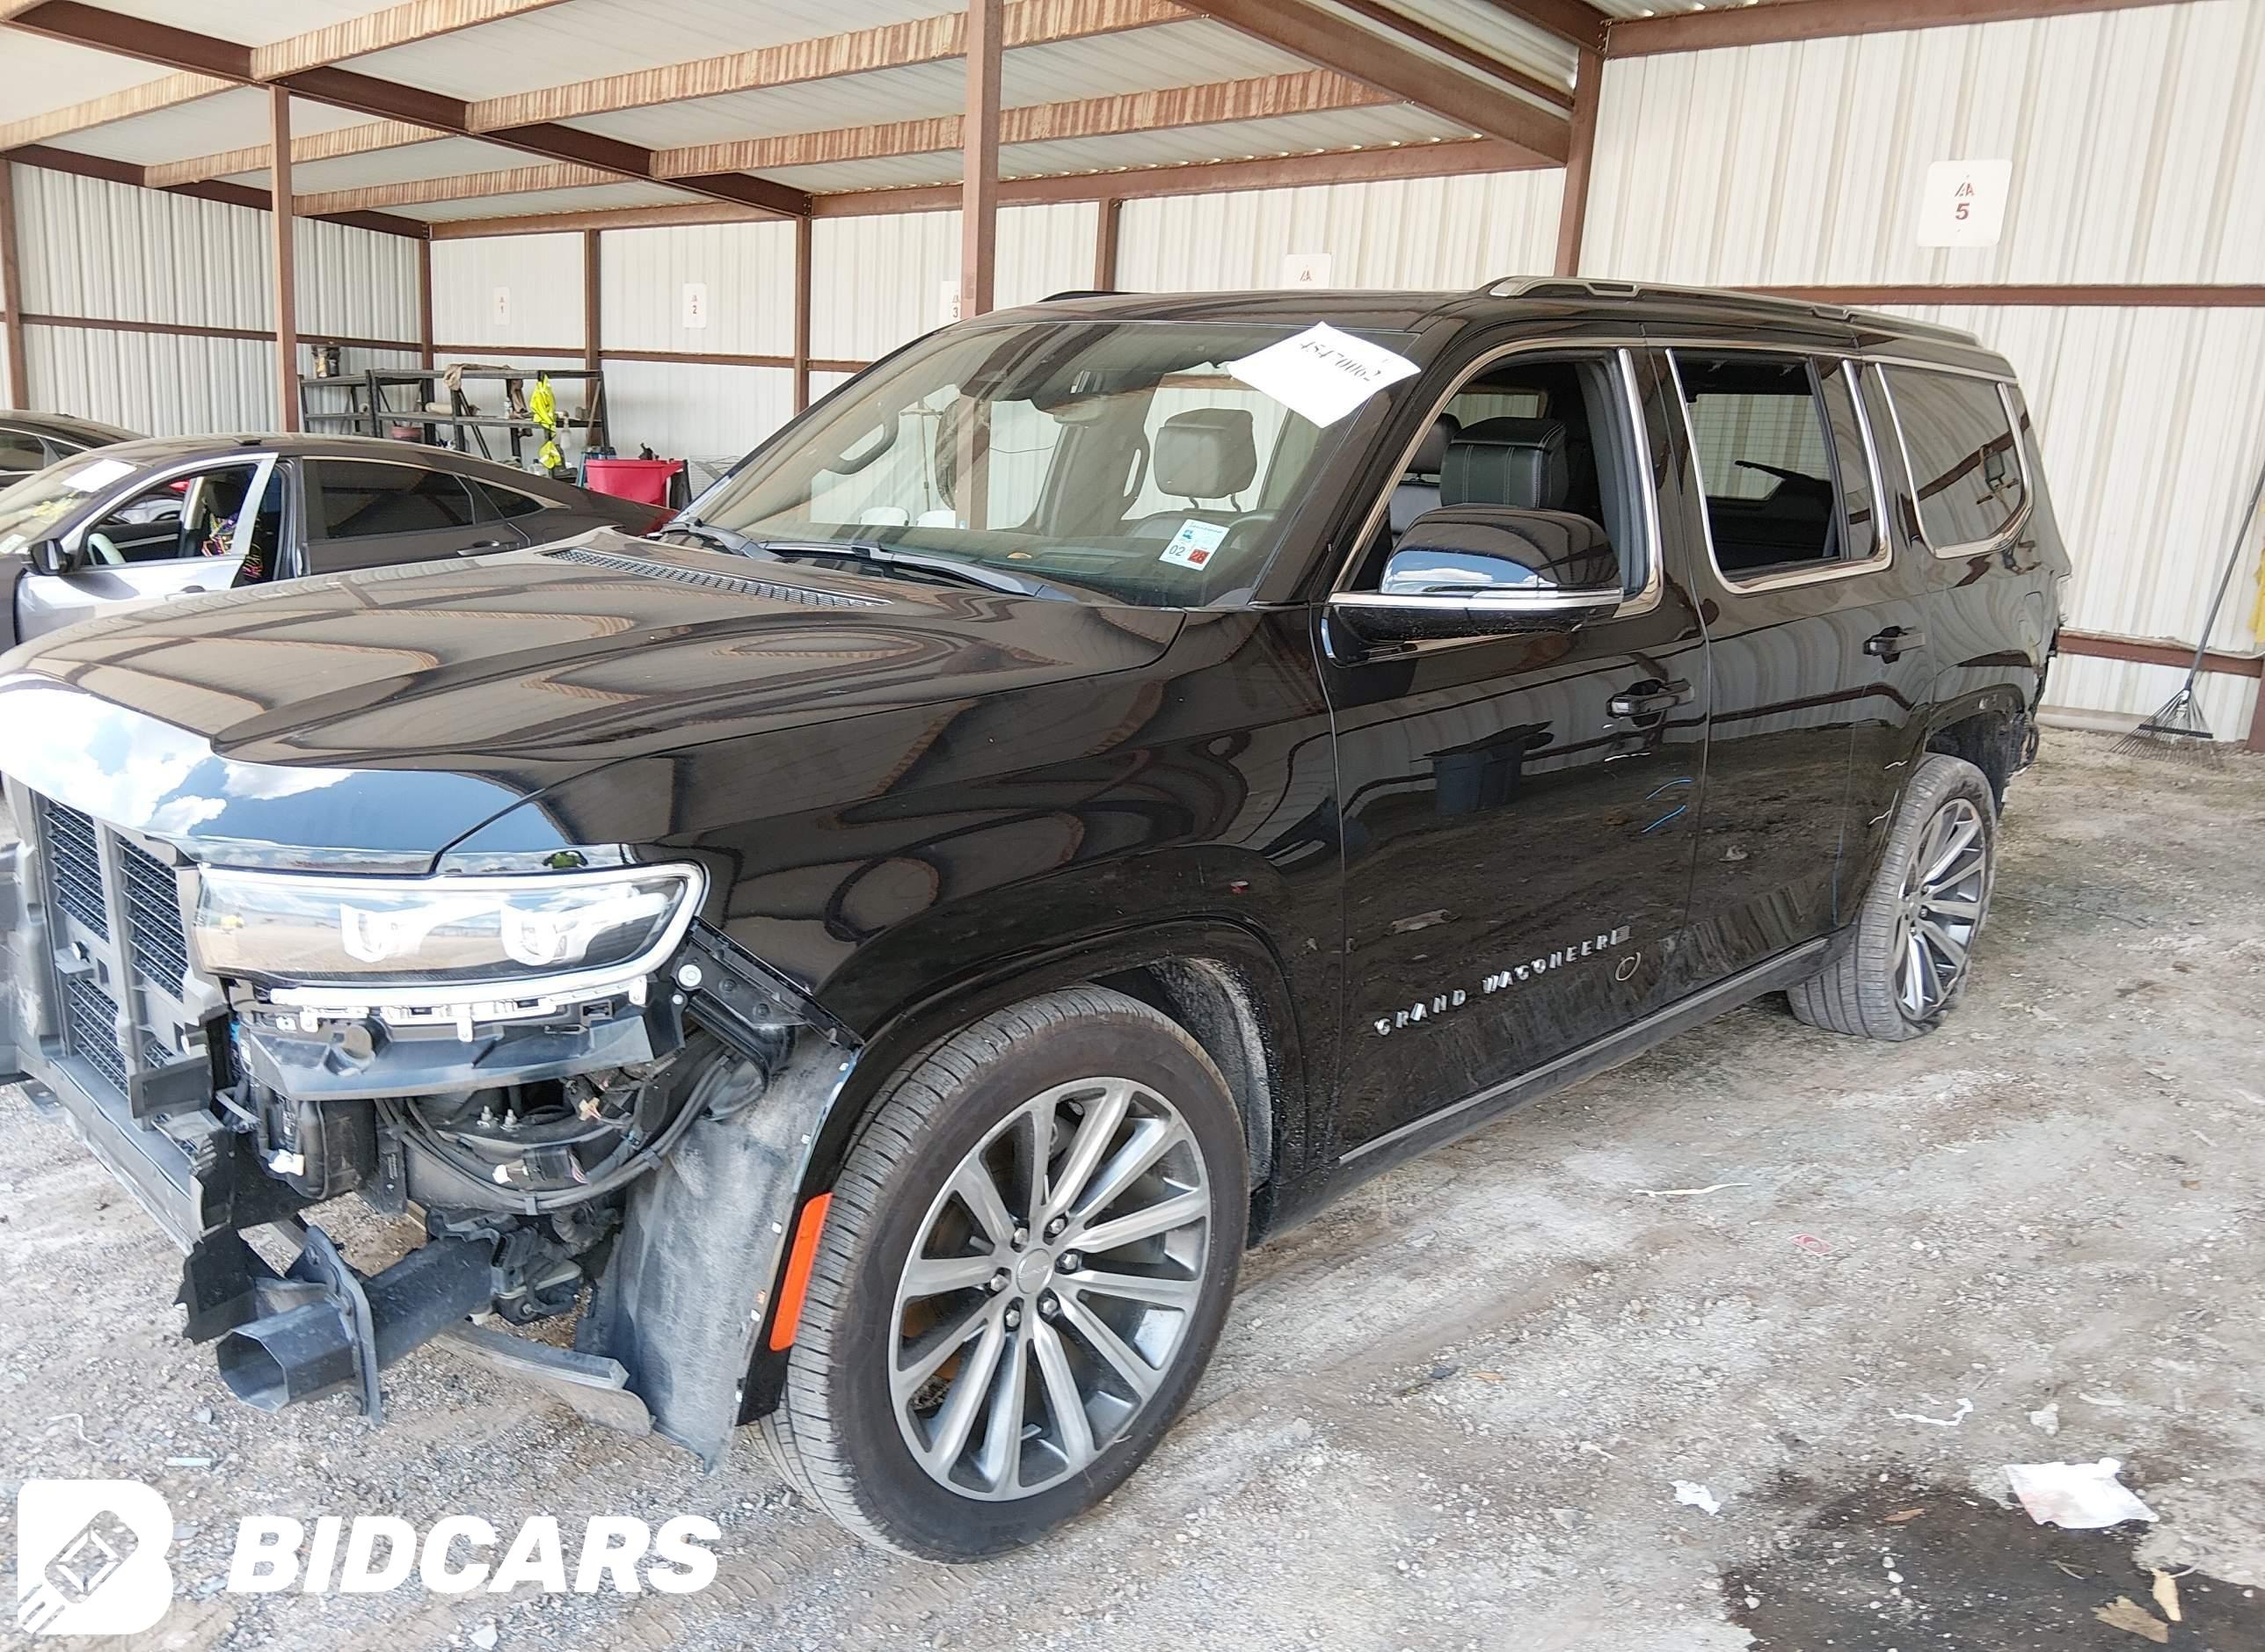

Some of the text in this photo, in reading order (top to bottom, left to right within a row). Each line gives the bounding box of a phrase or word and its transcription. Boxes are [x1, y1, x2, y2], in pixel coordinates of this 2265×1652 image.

[1955, 202, 1970, 221] 5
[952, 307, 959, 318] 3
[1169, 544, 1186, 557] 02
[1373, 988, 1468, 1037] GRAND
